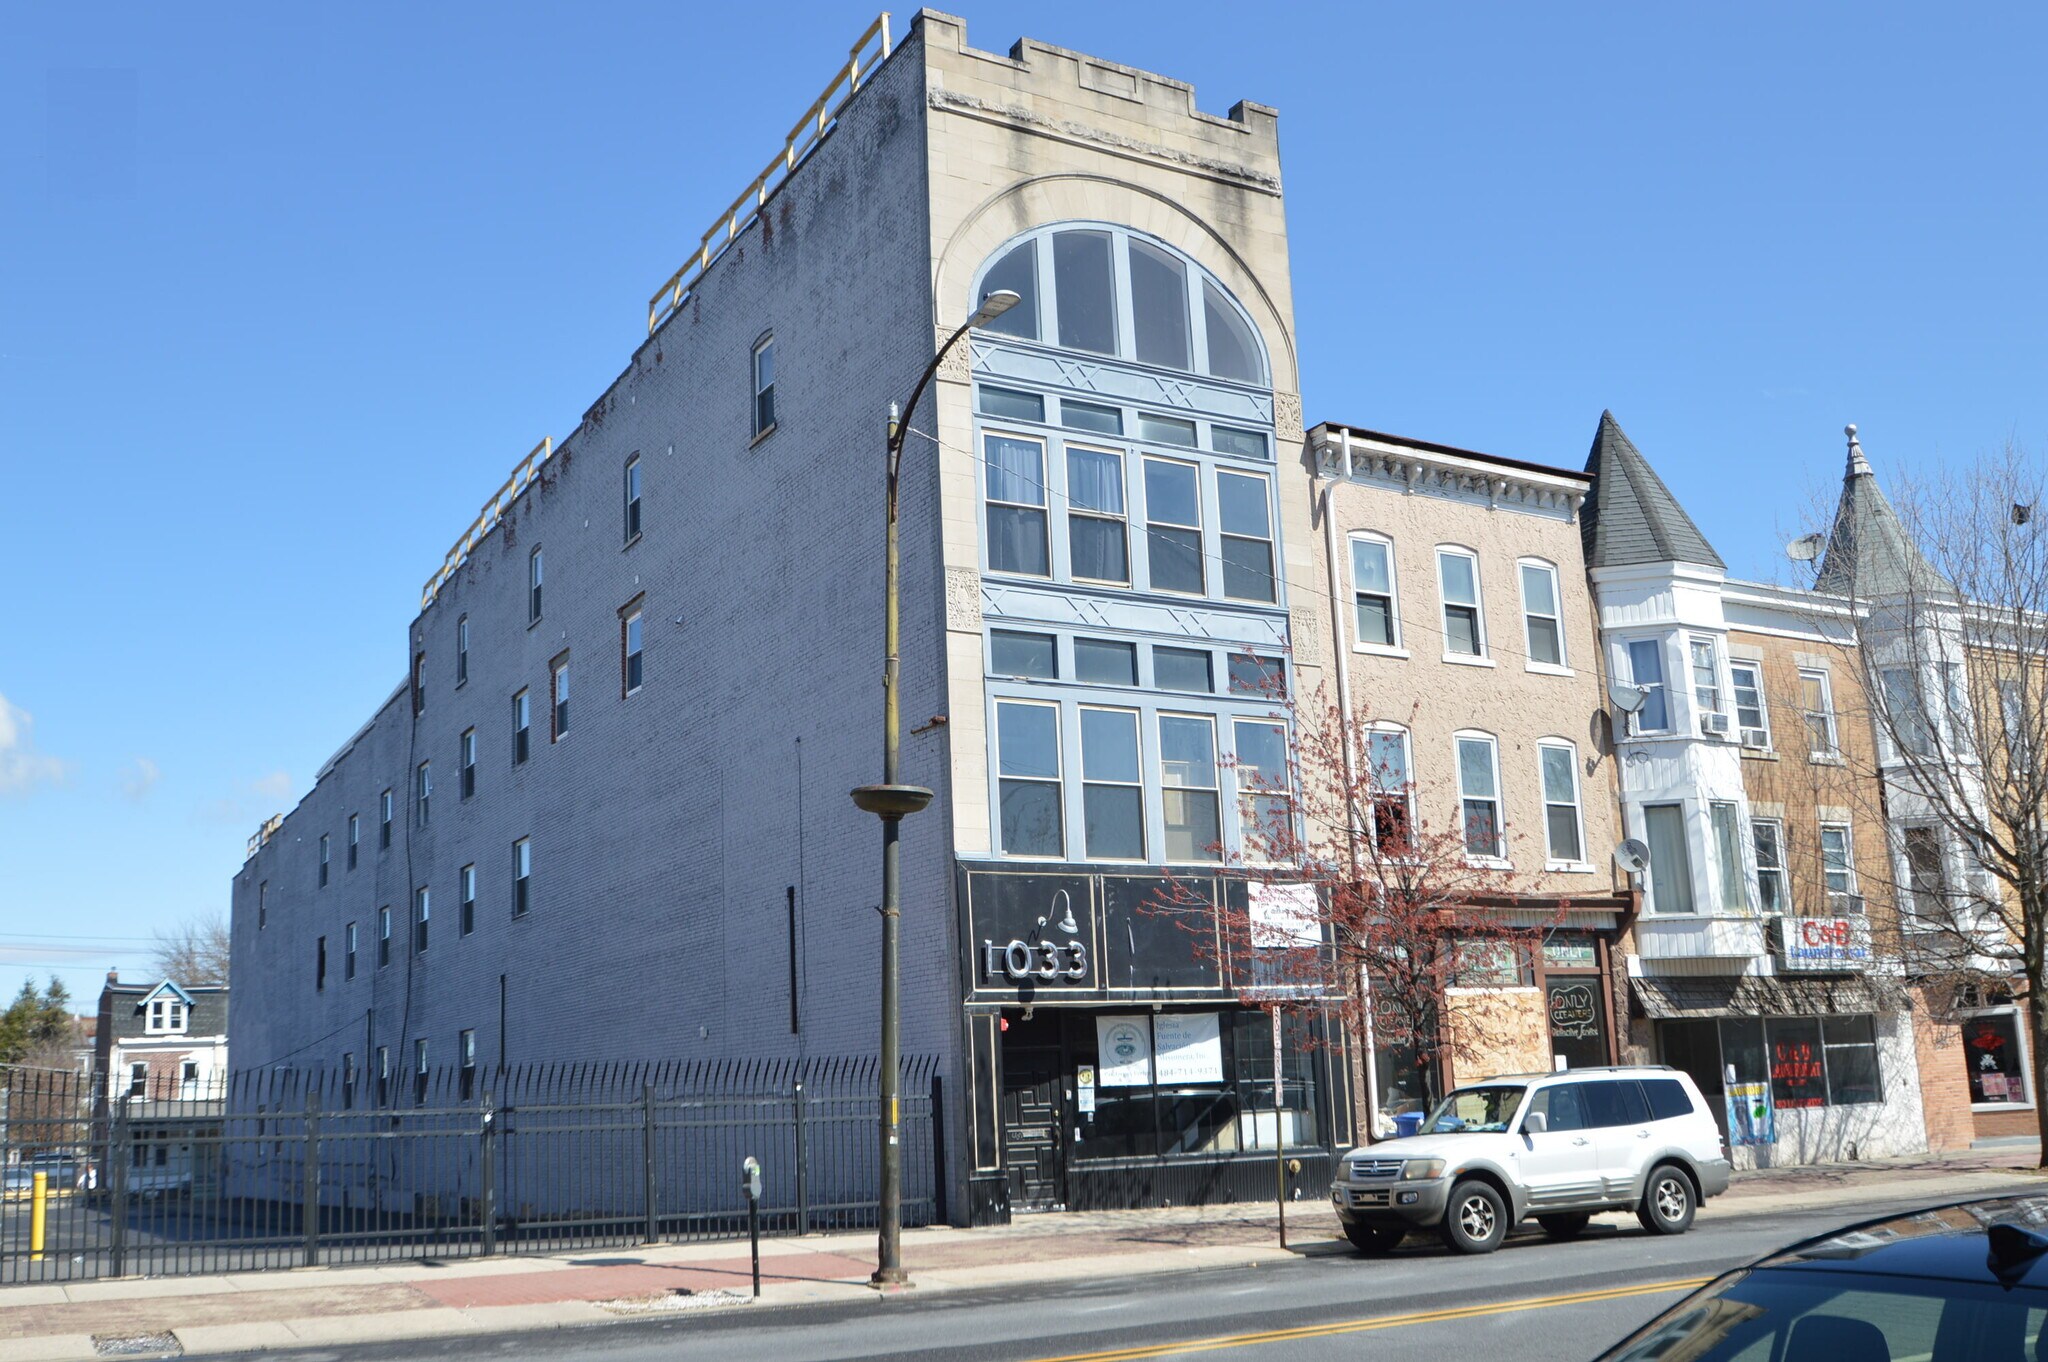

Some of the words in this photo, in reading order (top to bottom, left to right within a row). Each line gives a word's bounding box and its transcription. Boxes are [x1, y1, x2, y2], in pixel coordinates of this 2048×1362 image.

[985, 939, 1088, 979] 1033
[1554, 994, 1589, 1009] ONLY
[1554, 1008, 1593, 1020] CLEANERS
[1156, 1021, 1179, 1031] Iglesia
[1156, 1031, 1182, 1040] Fuente
[1182, 1030, 1192, 1039] de
